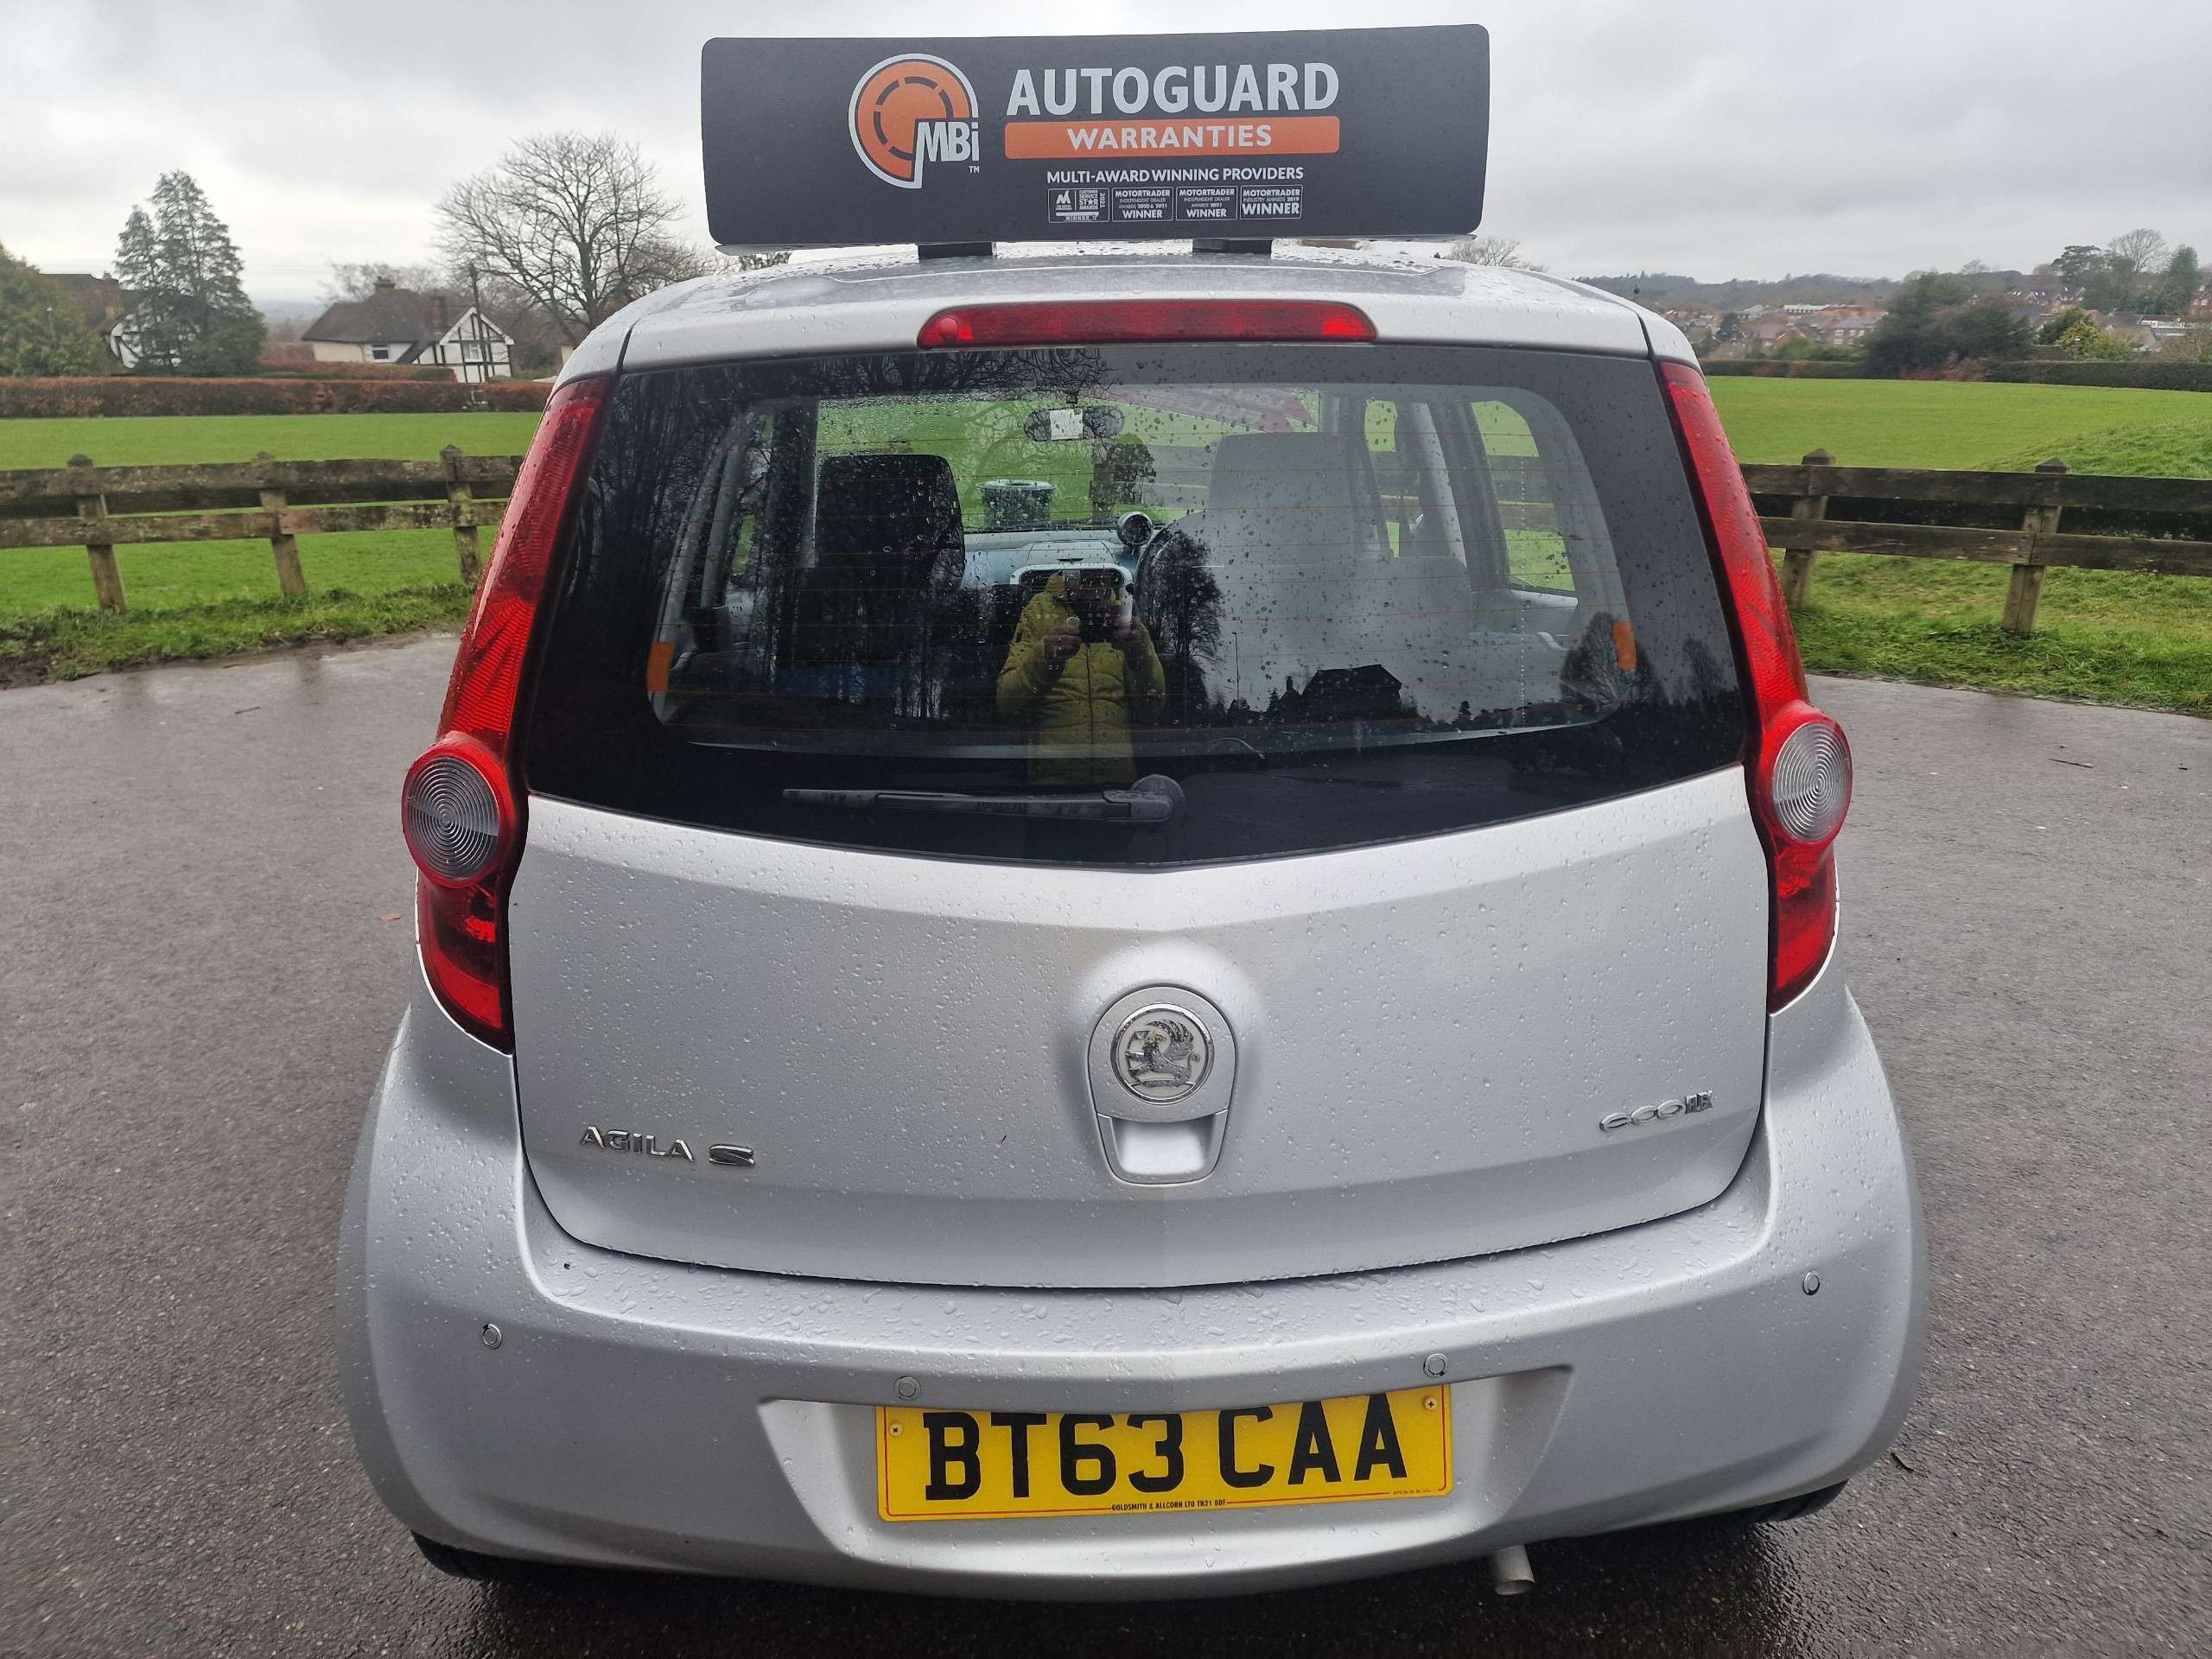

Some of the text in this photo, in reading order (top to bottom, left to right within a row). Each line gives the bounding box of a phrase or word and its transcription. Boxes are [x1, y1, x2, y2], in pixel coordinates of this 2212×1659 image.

[1006, 63, 1339, 116] AUTOGUARD
[916, 121, 980, 162] MBi
[1067, 124, 1273, 150] WARRANTIES
[1046, 166, 1305, 184] MULTI-AWARD WINNING PROVIDERS
[1115, 189, 1171, 198] MOTORTRADER
[1179, 188, 1236, 197] MOTORTRADER
[1243, 188, 1300, 197] MOTORTRADER
[1122, 209, 1163, 219] WINNER
[1185, 208, 1227, 219] WINNER
[1241, 202, 1300, 215] WINNER
[579, 1124, 756, 1168] AGILA S
[922, 1393, 1408, 1501] BT63 CAA
[1111, 1503, 1147, 1511] GOLDSMITH
[1154, 1500, 1183, 1510] ALLCORN
